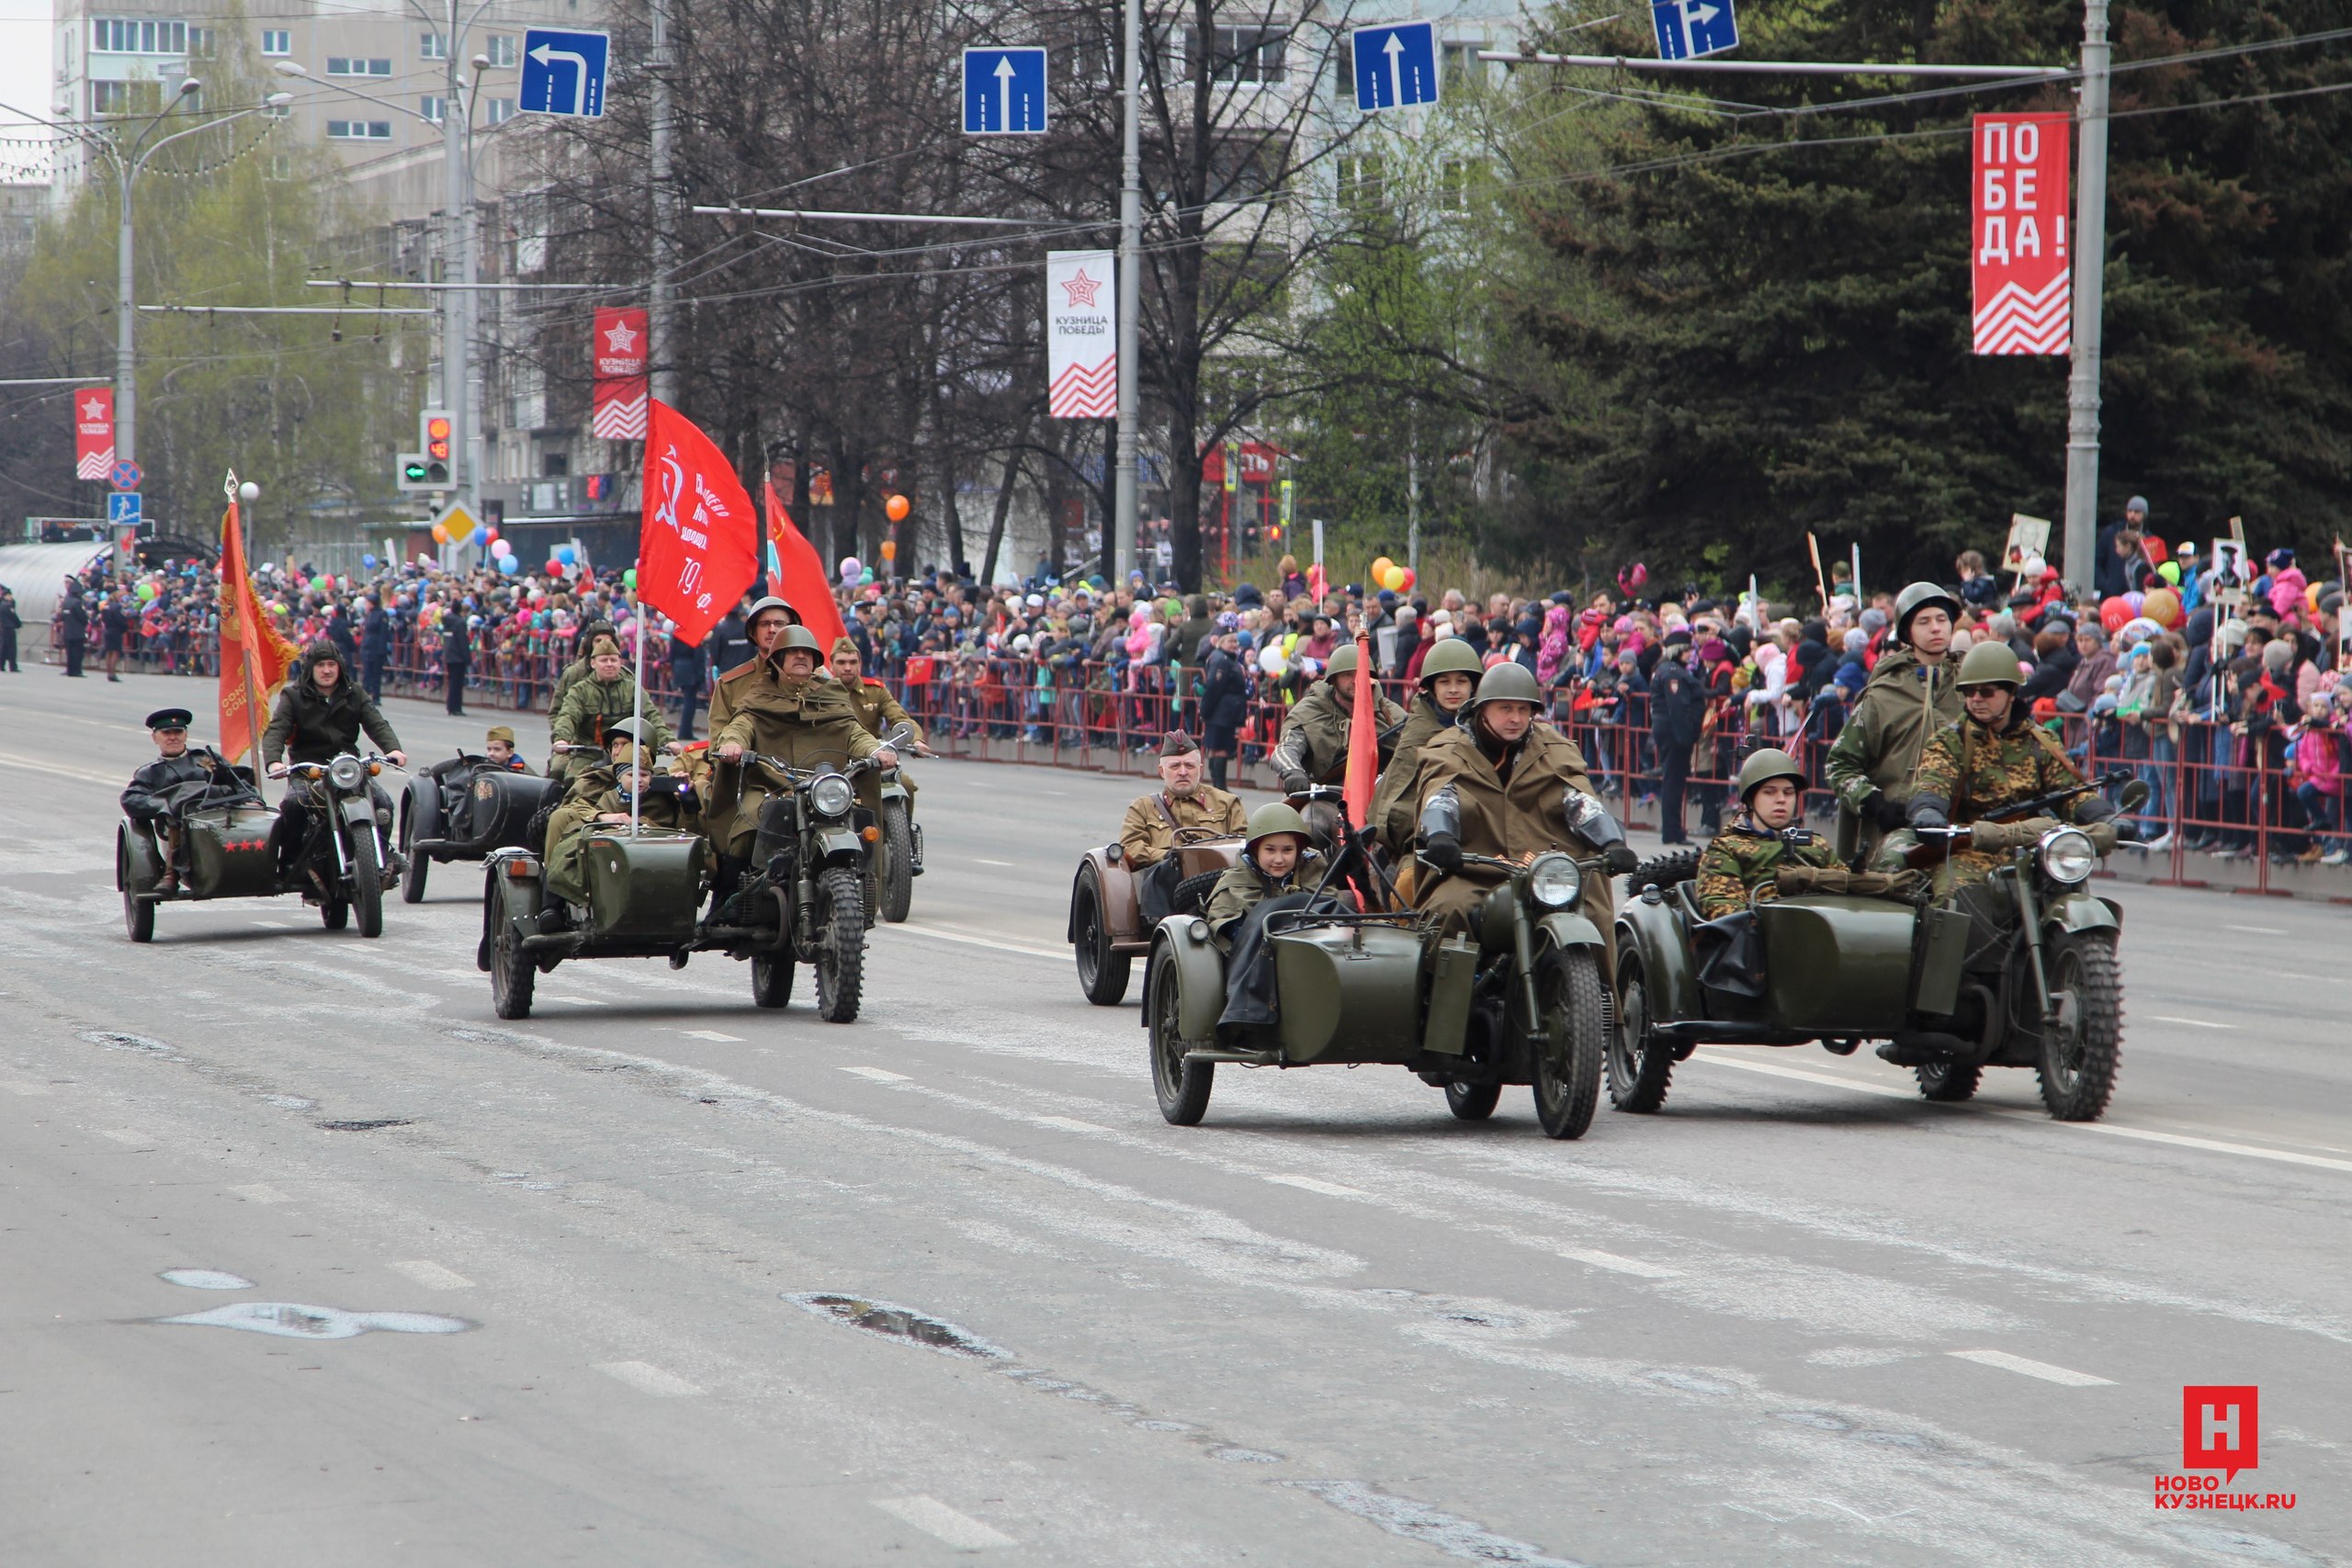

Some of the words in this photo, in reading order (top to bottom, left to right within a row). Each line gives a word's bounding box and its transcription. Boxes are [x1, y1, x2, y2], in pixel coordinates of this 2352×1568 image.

[1983, 121, 2040, 164] ПО
[1983, 168, 2038, 211] БЕ
[1056, 315, 1109, 325] КУЗНИЦА
[1058, 325, 1105, 336] ПОБЕДЫ
